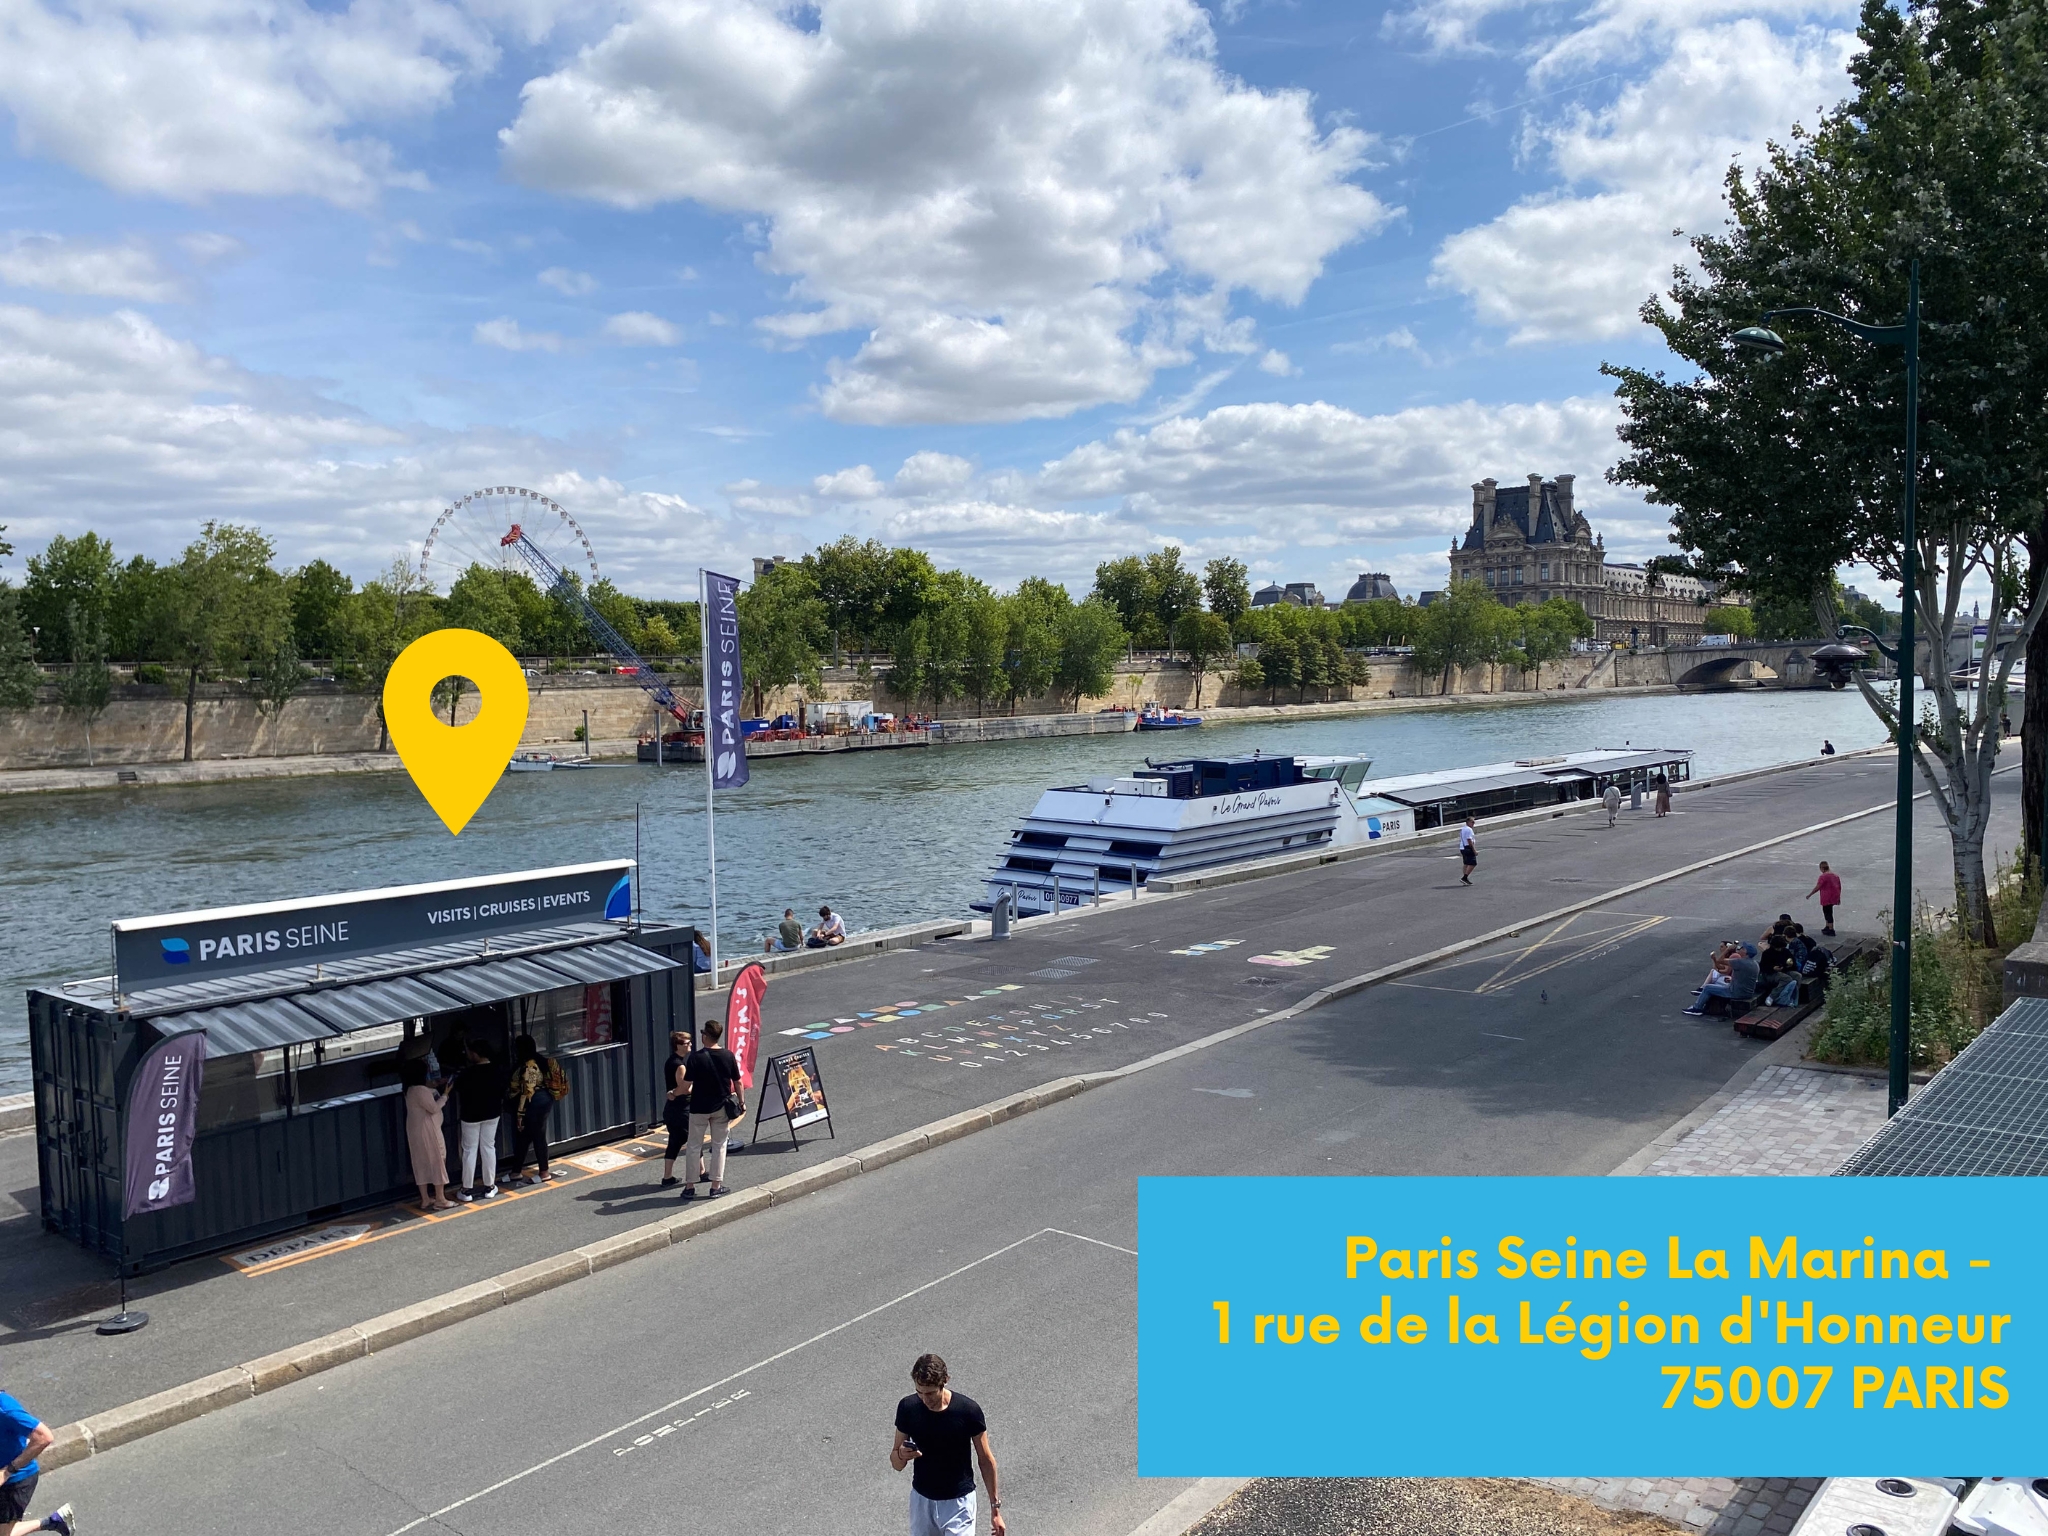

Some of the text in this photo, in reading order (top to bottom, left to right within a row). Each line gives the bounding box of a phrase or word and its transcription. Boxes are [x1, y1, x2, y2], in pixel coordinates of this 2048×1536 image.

[717, 581, 737, 745] PARIS SEINE
[1221, 797, 1231, 814] Le
[1233, 795, 1257, 813] Grand
[1382, 820, 1400, 831] PARIS
[427, 890, 591, 924] VISITS CRUISES EVENTS
[199, 921, 349, 961] PARIS SEINE
[154, 1055, 182, 1176] PARIS SEINE
